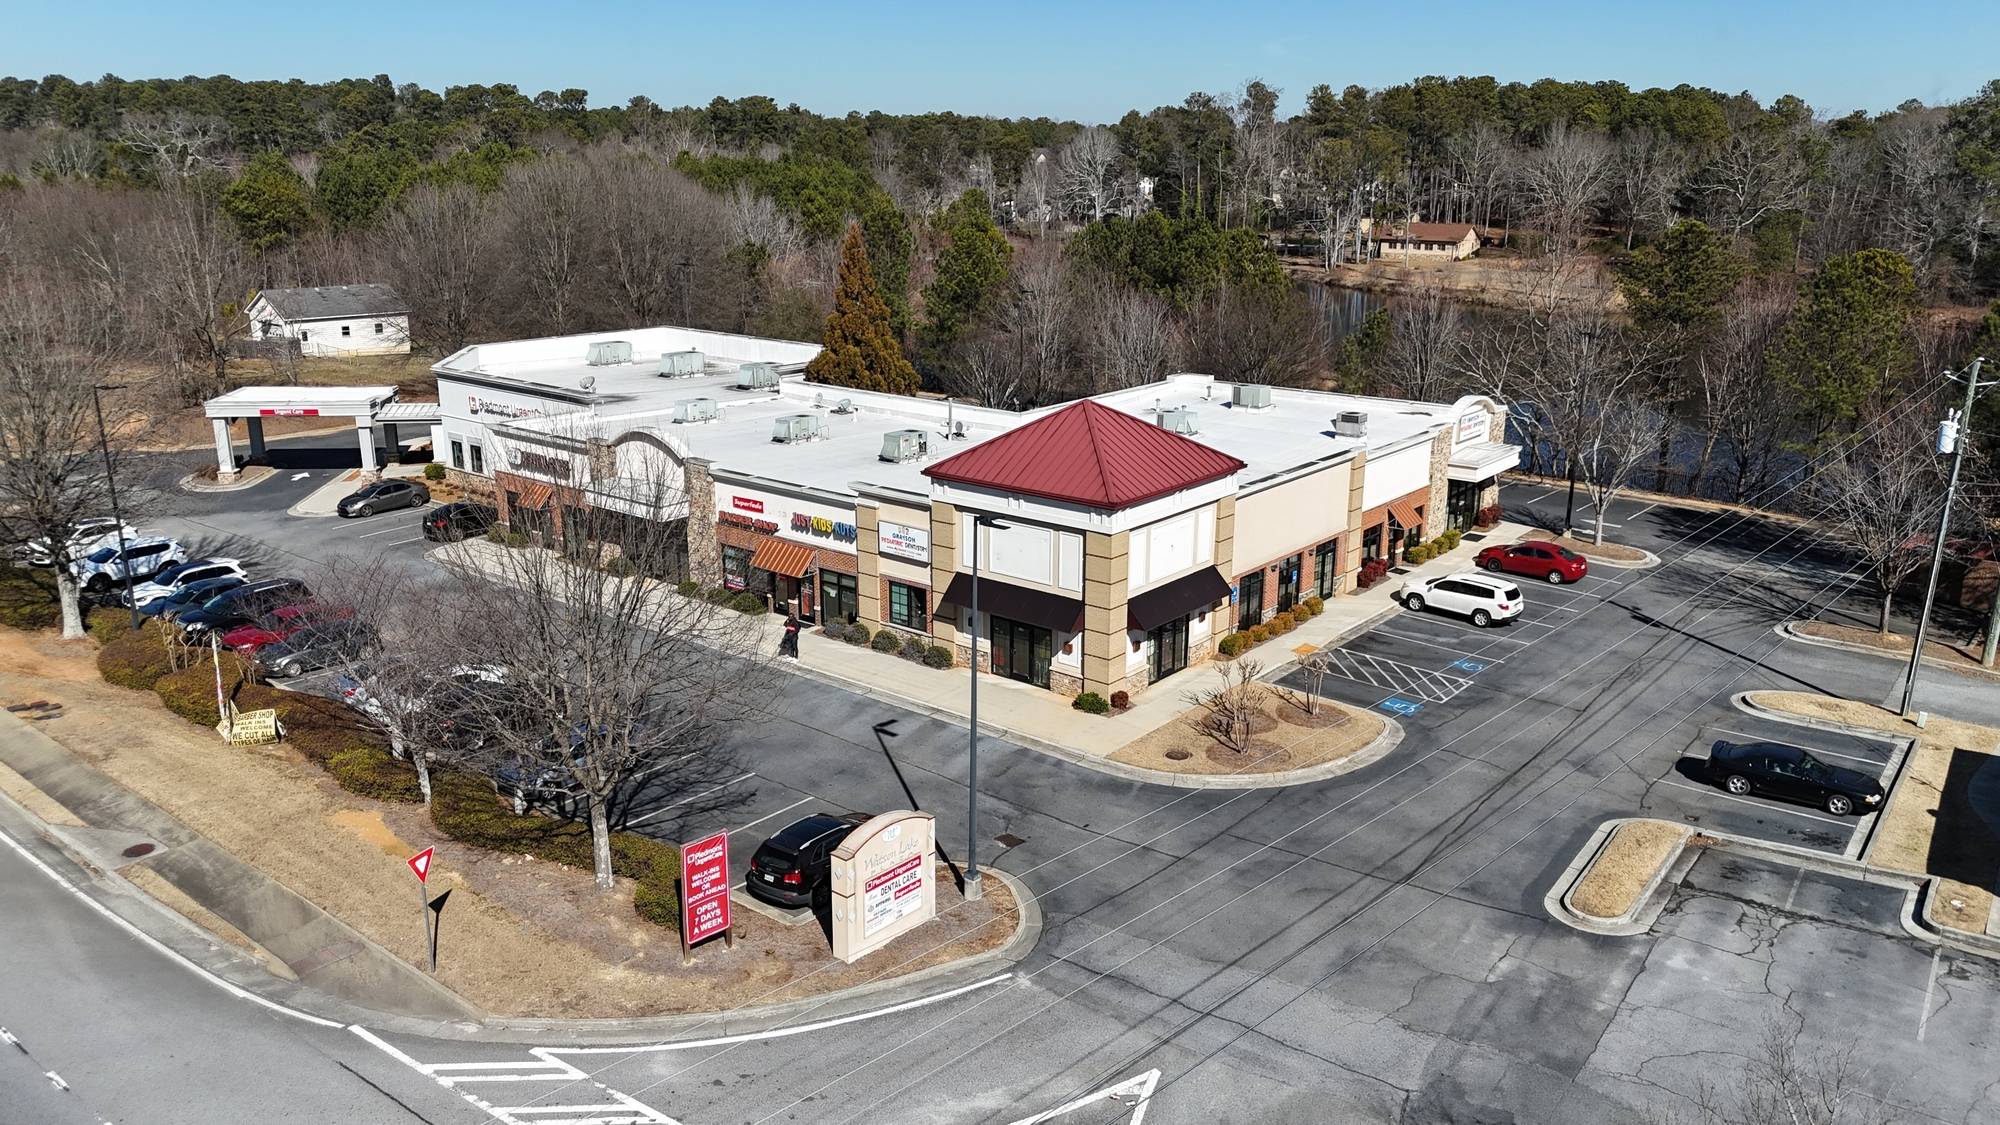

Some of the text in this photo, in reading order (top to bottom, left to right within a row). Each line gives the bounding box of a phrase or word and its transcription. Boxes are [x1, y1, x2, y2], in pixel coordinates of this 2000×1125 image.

[734, 498, 762, 510] Superfade
[791, 511, 857, 539] JUST KIDS KUTS
[881, 537, 904, 547] PEDIATRIC
[904, 542, 928, 553] DENTISTRY
[892, 532, 916, 543] GRAYSON
[258, 711, 273, 719] SHOP
[232, 732, 242, 740] WE
[244, 731, 258, 739] CUT
[694, 844, 723, 859] Piedmont
[694, 851, 724, 866] UrgentCare
[691, 865, 720, 881] WALK-INS
[691, 872, 721, 888] WELCOME
[872, 872, 895, 887] Piedmont
[894, 858, 920, 875] UrgentCare
[701, 882, 711, 891] OR
[880, 870, 918, 896] DENTAL CARE
[688, 883, 726, 904] BOOK AHEAD
[696, 900, 718, 915] OPEN
[694, 908, 721, 926] 7 DAYS
[693, 916, 724, 936] A WEEK
